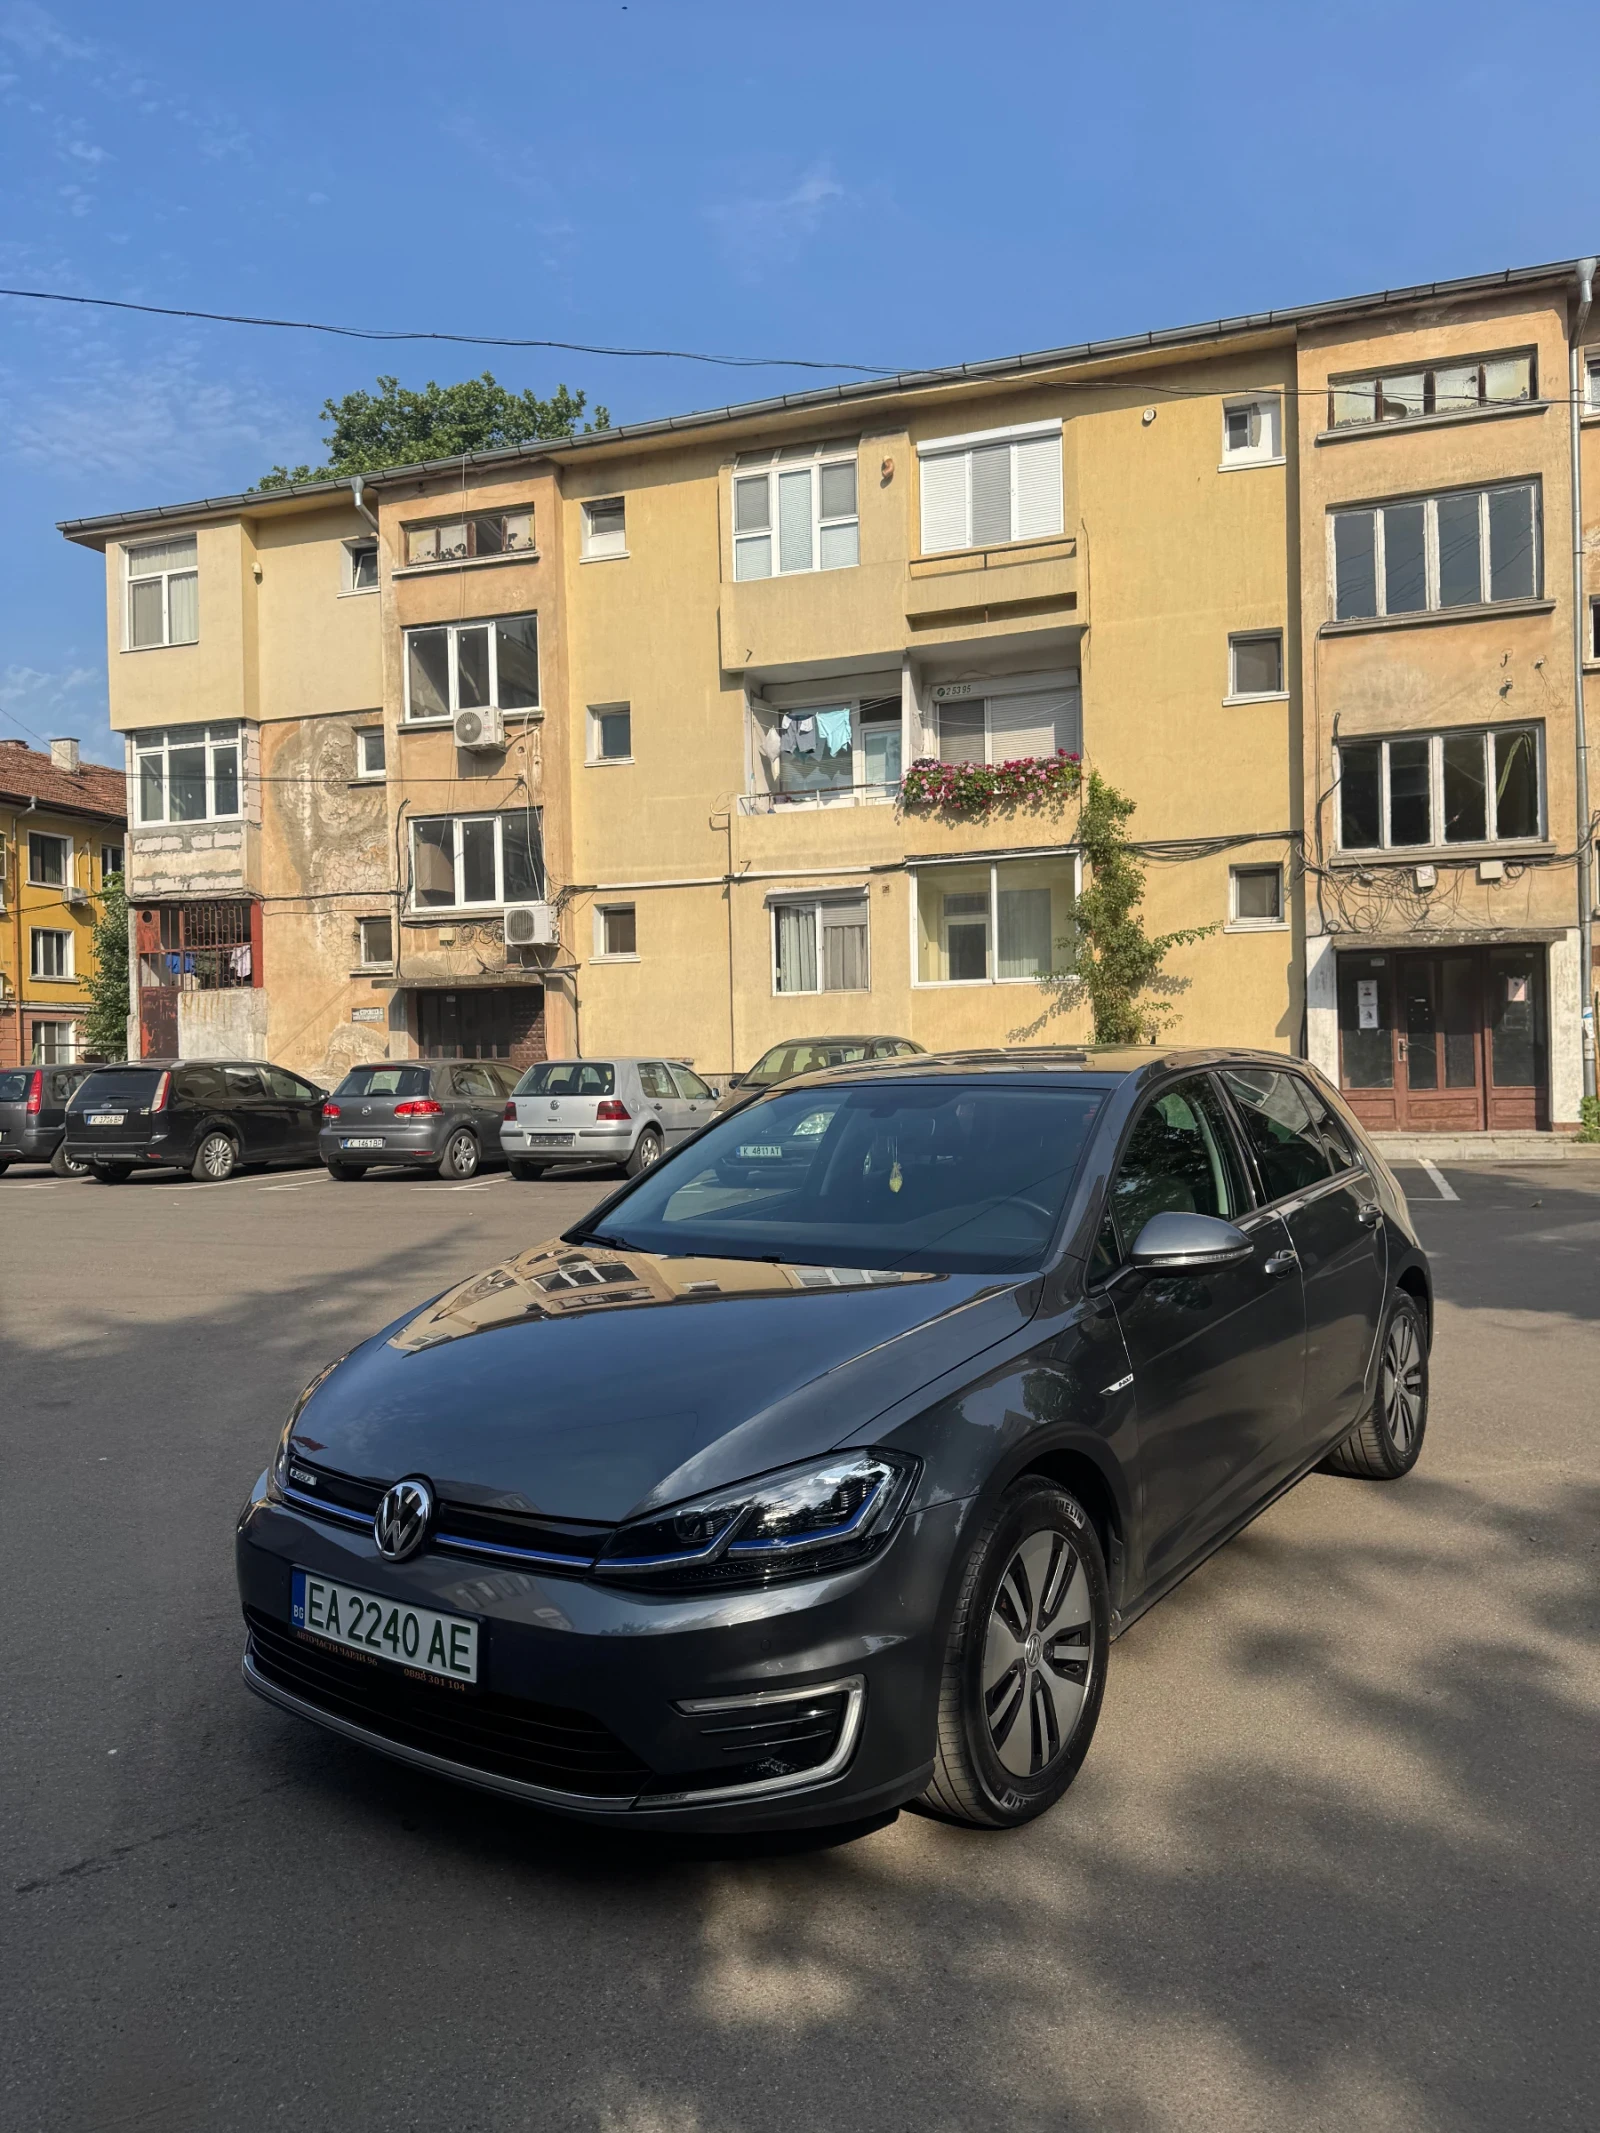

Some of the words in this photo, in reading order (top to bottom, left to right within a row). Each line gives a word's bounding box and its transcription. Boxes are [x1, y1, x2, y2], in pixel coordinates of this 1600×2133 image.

[293, 1604, 304, 1619] BG
[308, 1581, 341, 1635] EA
[347, 1596, 420, 1658] 2240
[427, 1619, 471, 1674] AE
[428, 1675, 445, 1686] 301
[449, 1680, 465, 1691] 104
